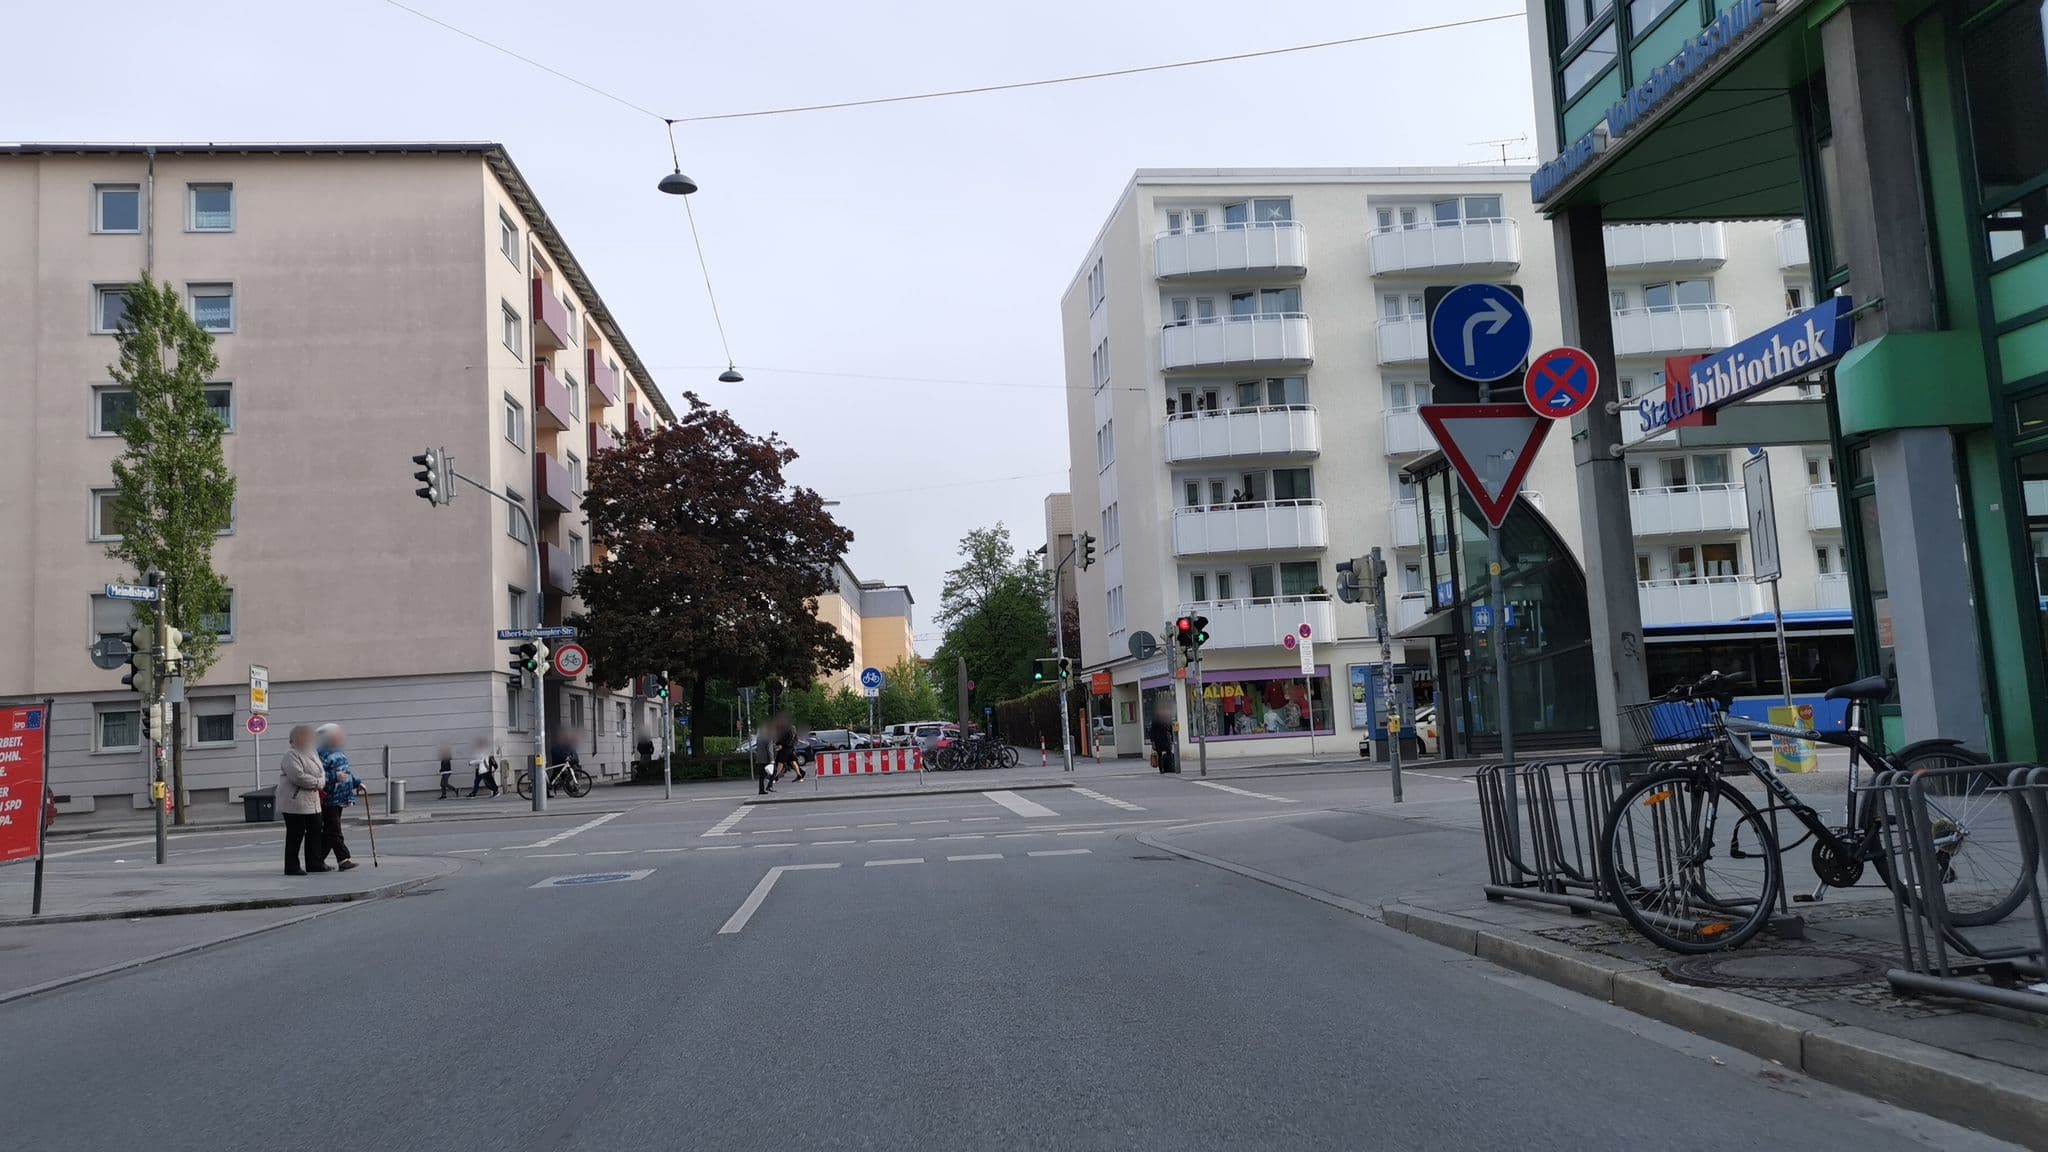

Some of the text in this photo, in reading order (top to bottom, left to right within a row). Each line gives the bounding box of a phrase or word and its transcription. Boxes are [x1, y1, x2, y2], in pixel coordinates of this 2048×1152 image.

[1639, 318, 1832, 432] Stadtbibliothek
[14, 721, 26, 729] SPD
[4, 799, 22, 811] SPD
